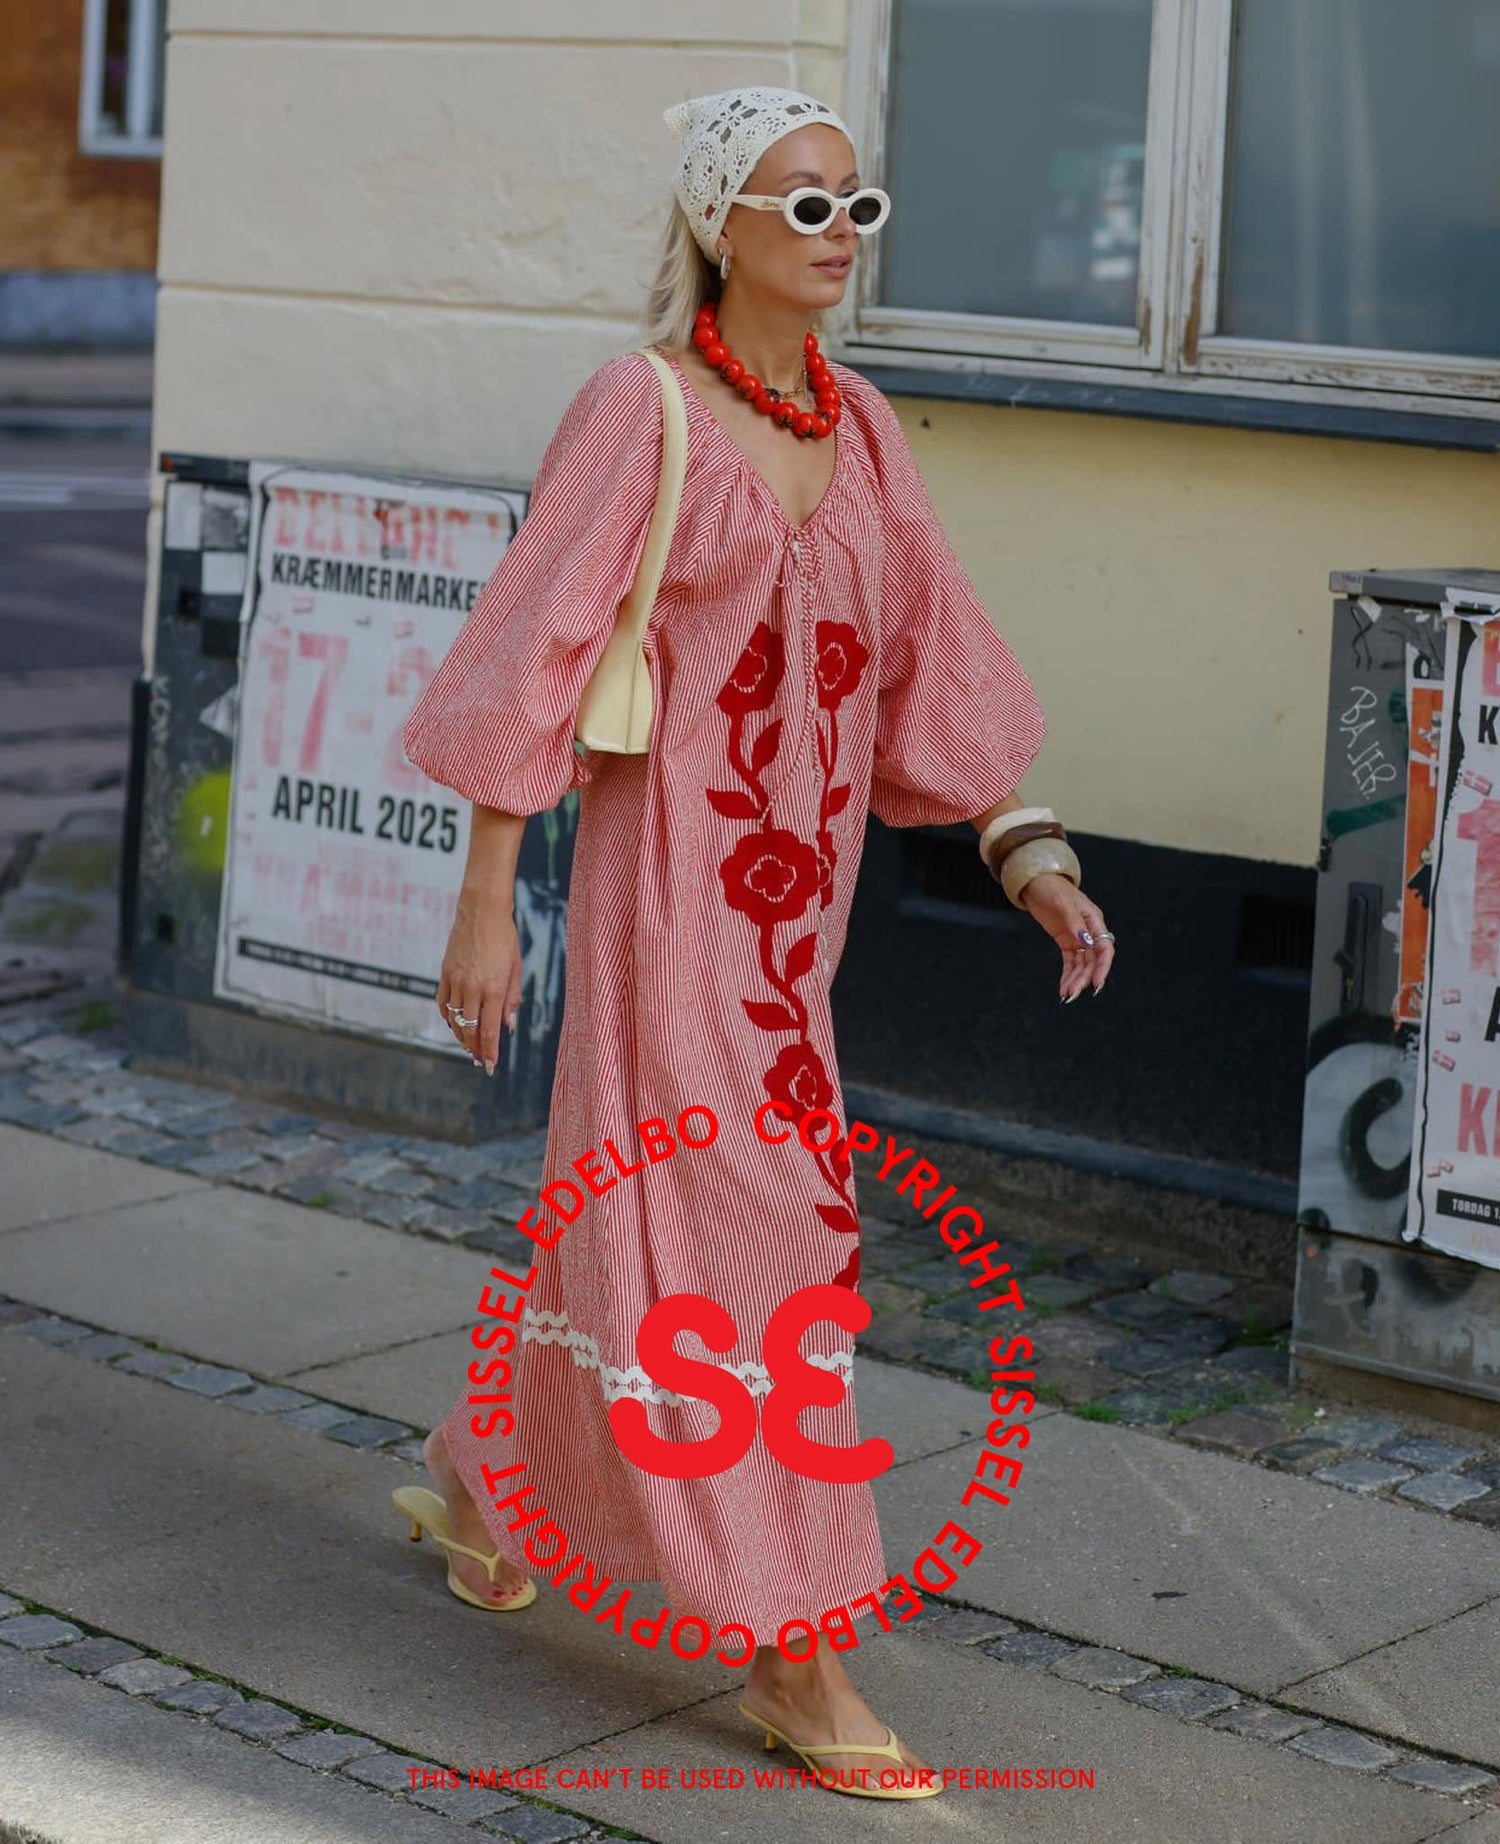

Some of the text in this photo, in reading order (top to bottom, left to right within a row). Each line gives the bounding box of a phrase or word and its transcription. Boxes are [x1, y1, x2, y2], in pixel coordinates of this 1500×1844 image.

[271, 552, 487, 612] KRÆMMERMARKE
[272, 775, 458, 854] APRIL 2025
